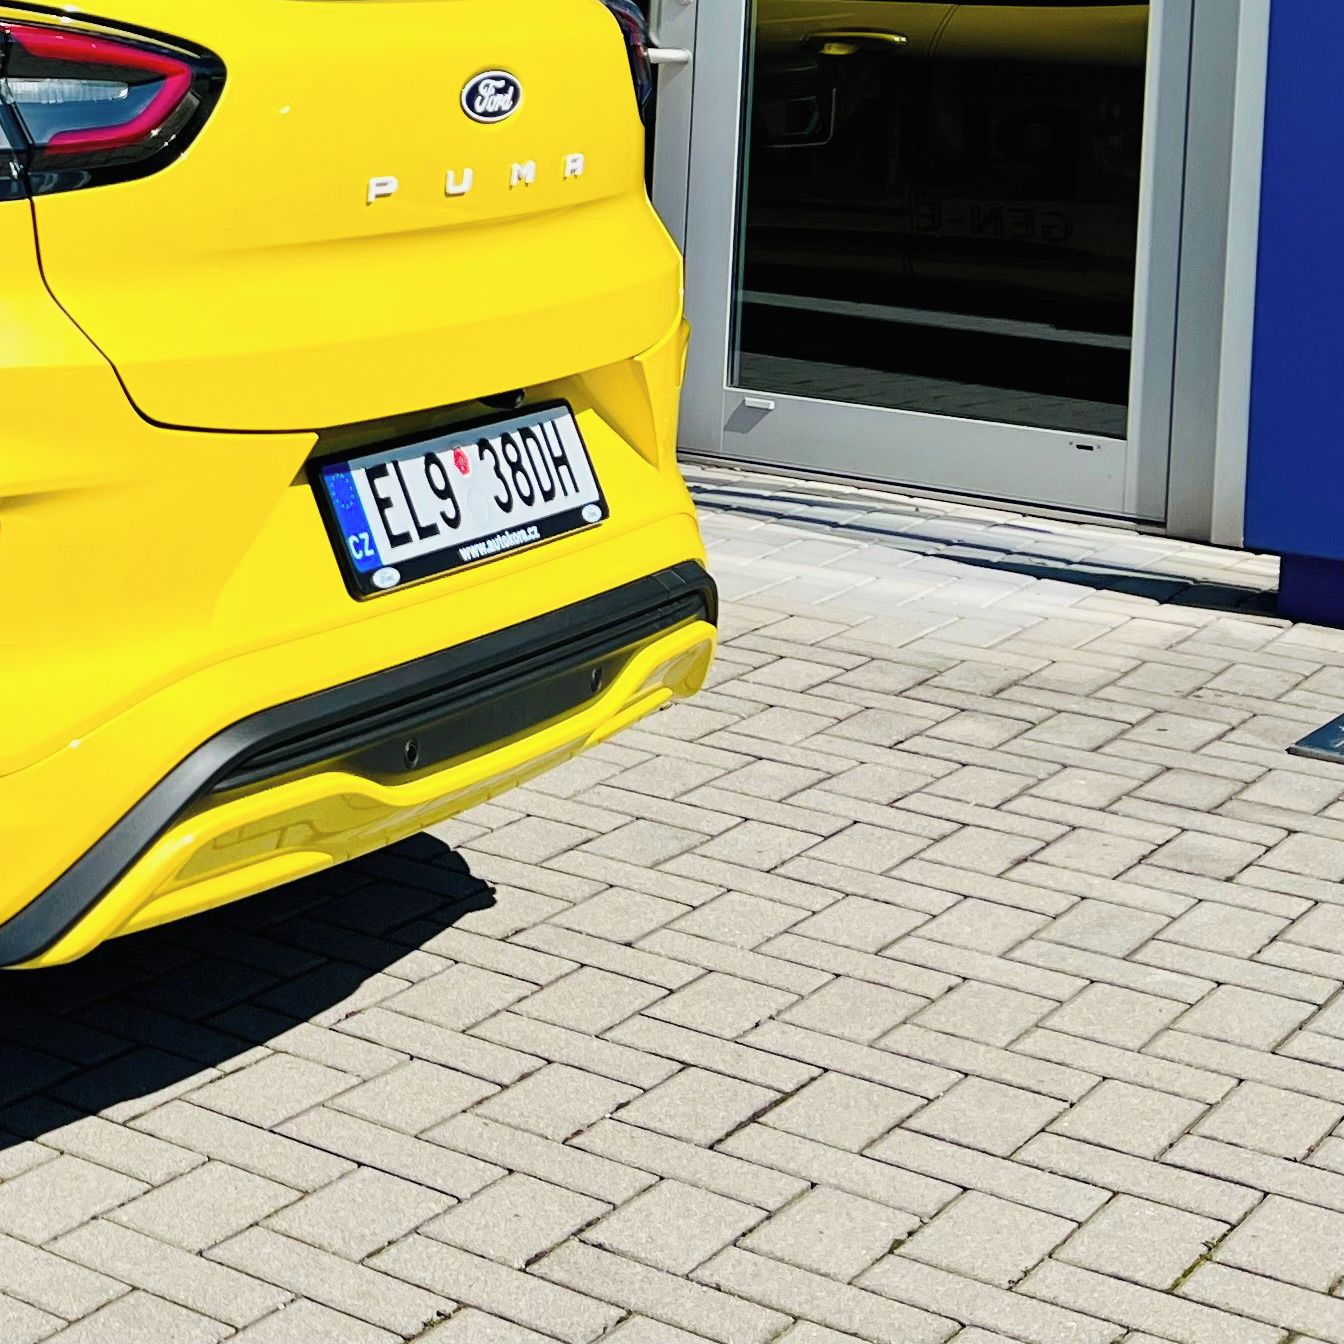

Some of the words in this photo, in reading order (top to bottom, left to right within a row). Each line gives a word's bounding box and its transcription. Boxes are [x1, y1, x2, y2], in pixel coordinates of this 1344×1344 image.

[474, 79, 515, 113] Ford
[367, 152, 585, 205] PUMA
[365, 451, 462, 549] EL9
[477, 420, 580, 514] 38DH
[348, 530, 375, 560] CZ
